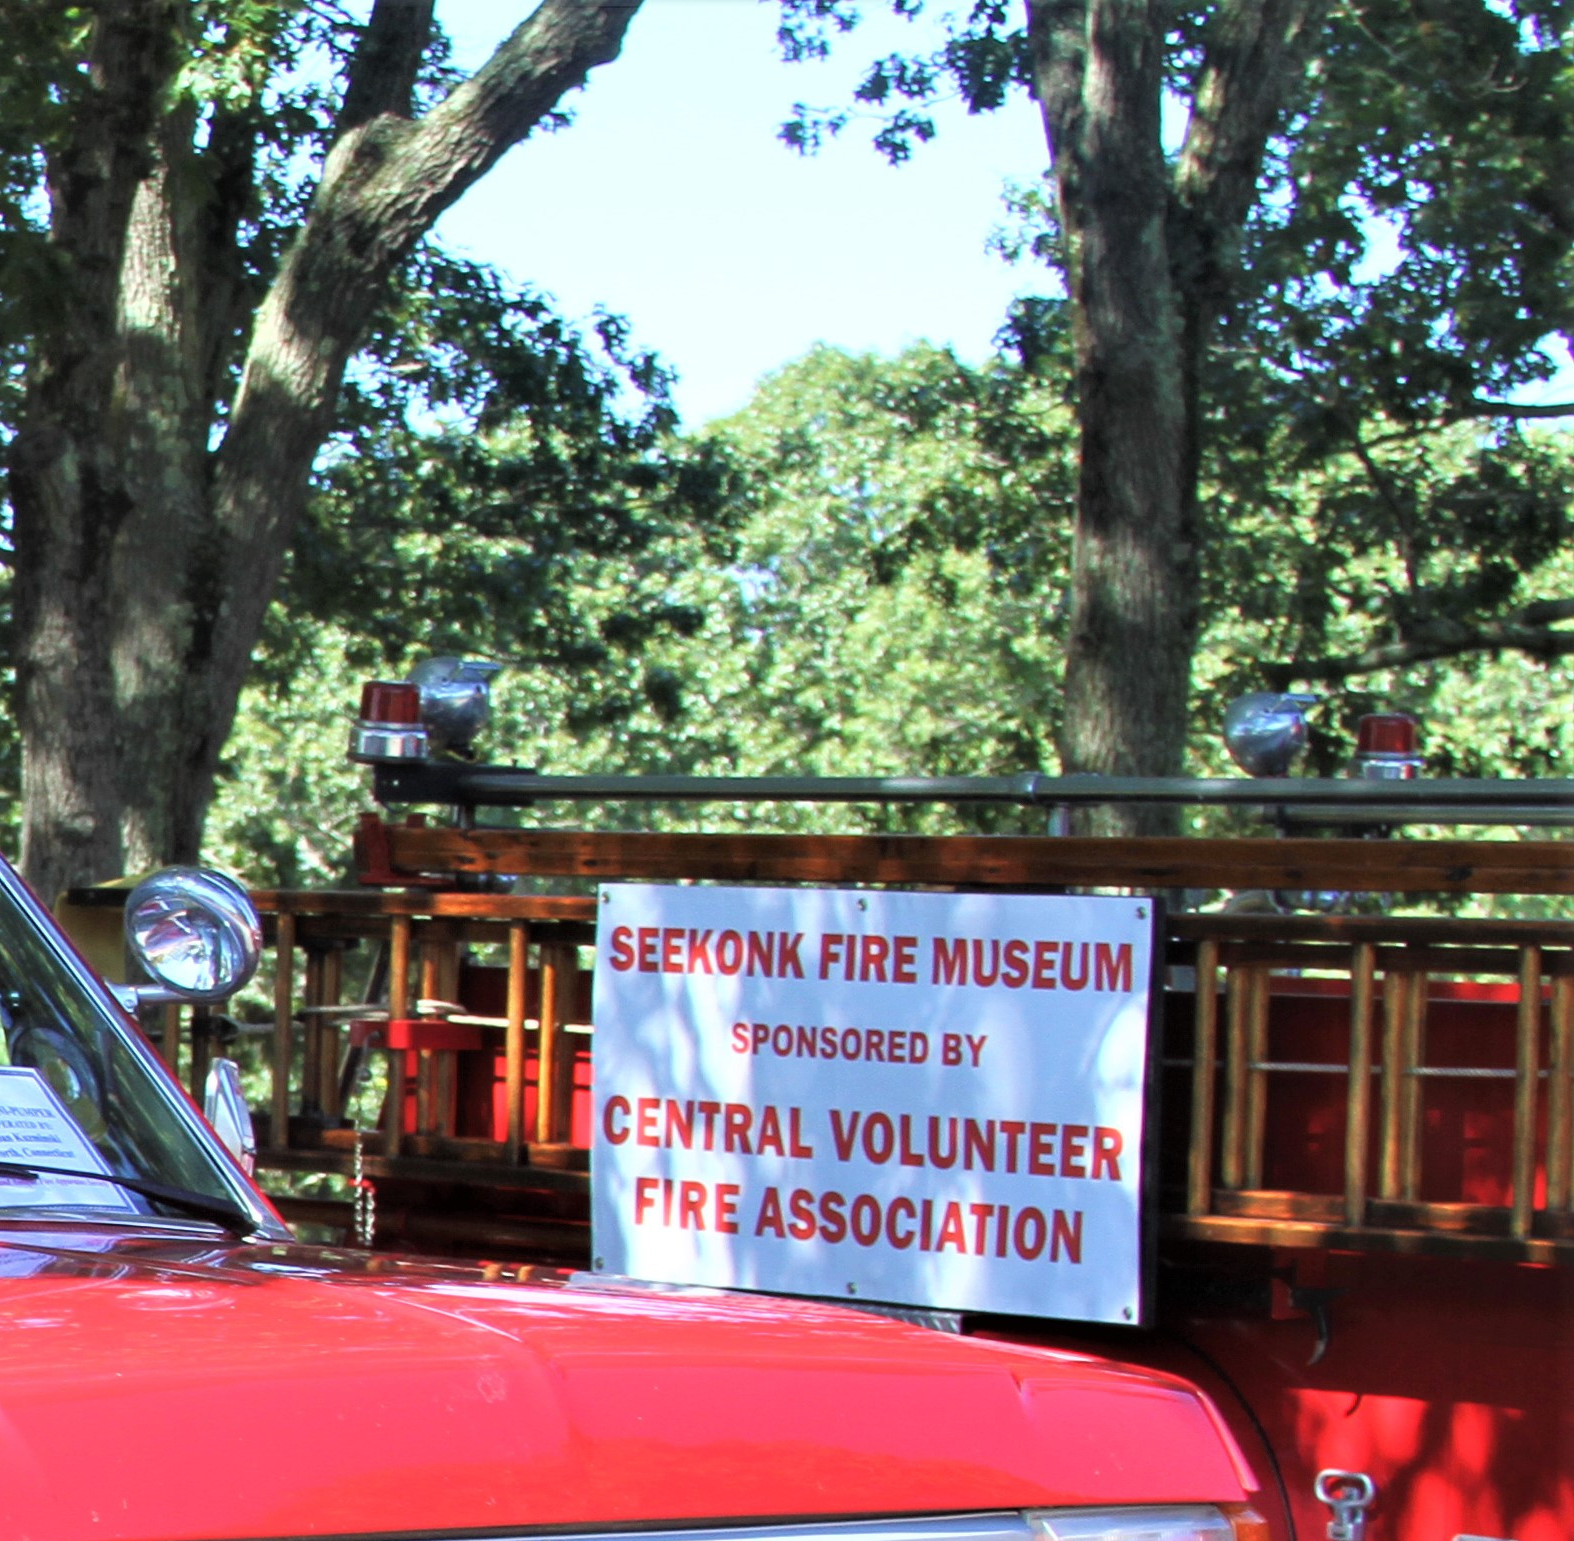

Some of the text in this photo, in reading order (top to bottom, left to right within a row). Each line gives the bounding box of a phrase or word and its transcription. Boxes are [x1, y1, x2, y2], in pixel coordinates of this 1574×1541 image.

[609, 926, 1133, 992] SEEKONK FIRE MUSEUM
[732, 1022, 988, 1067] SPONSORED BY
[603, 1095, 1124, 1181] CENTRAL VOLUNTEER
[635, 1177, 1083, 1264] FIRE ASSOCIATION
